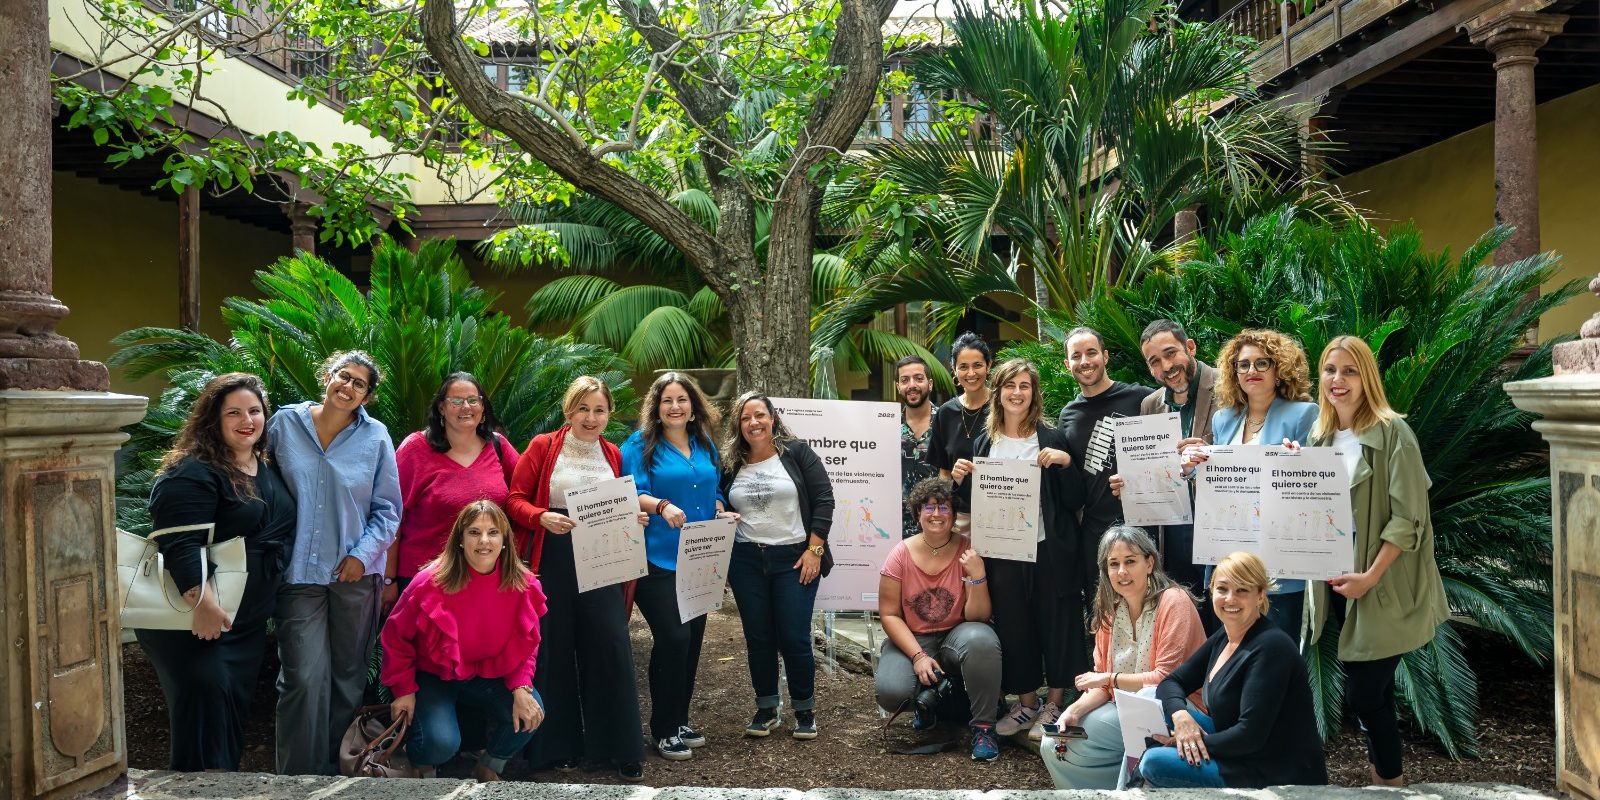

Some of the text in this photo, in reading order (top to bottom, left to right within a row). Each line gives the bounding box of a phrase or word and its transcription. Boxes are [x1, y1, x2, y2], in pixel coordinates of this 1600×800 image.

[1128, 434, 1156, 442] hombre
[1157, 433, 1170, 441] que
[808, 437, 877, 452] mbre que
[1123, 445, 1145, 454] quiero
[825, 456, 847, 465] ser
[1249, 466, 1261, 475] qu
[1281, 470, 1318, 478] hombre
[1319, 471, 1336, 479] que
[1206, 475, 1232, 484] quiero
[1272, 480, 1302, 490] quiero
[585, 499, 612, 510] hombre
[614, 496, 627, 505] que
[579, 511, 601, 522] quiero
